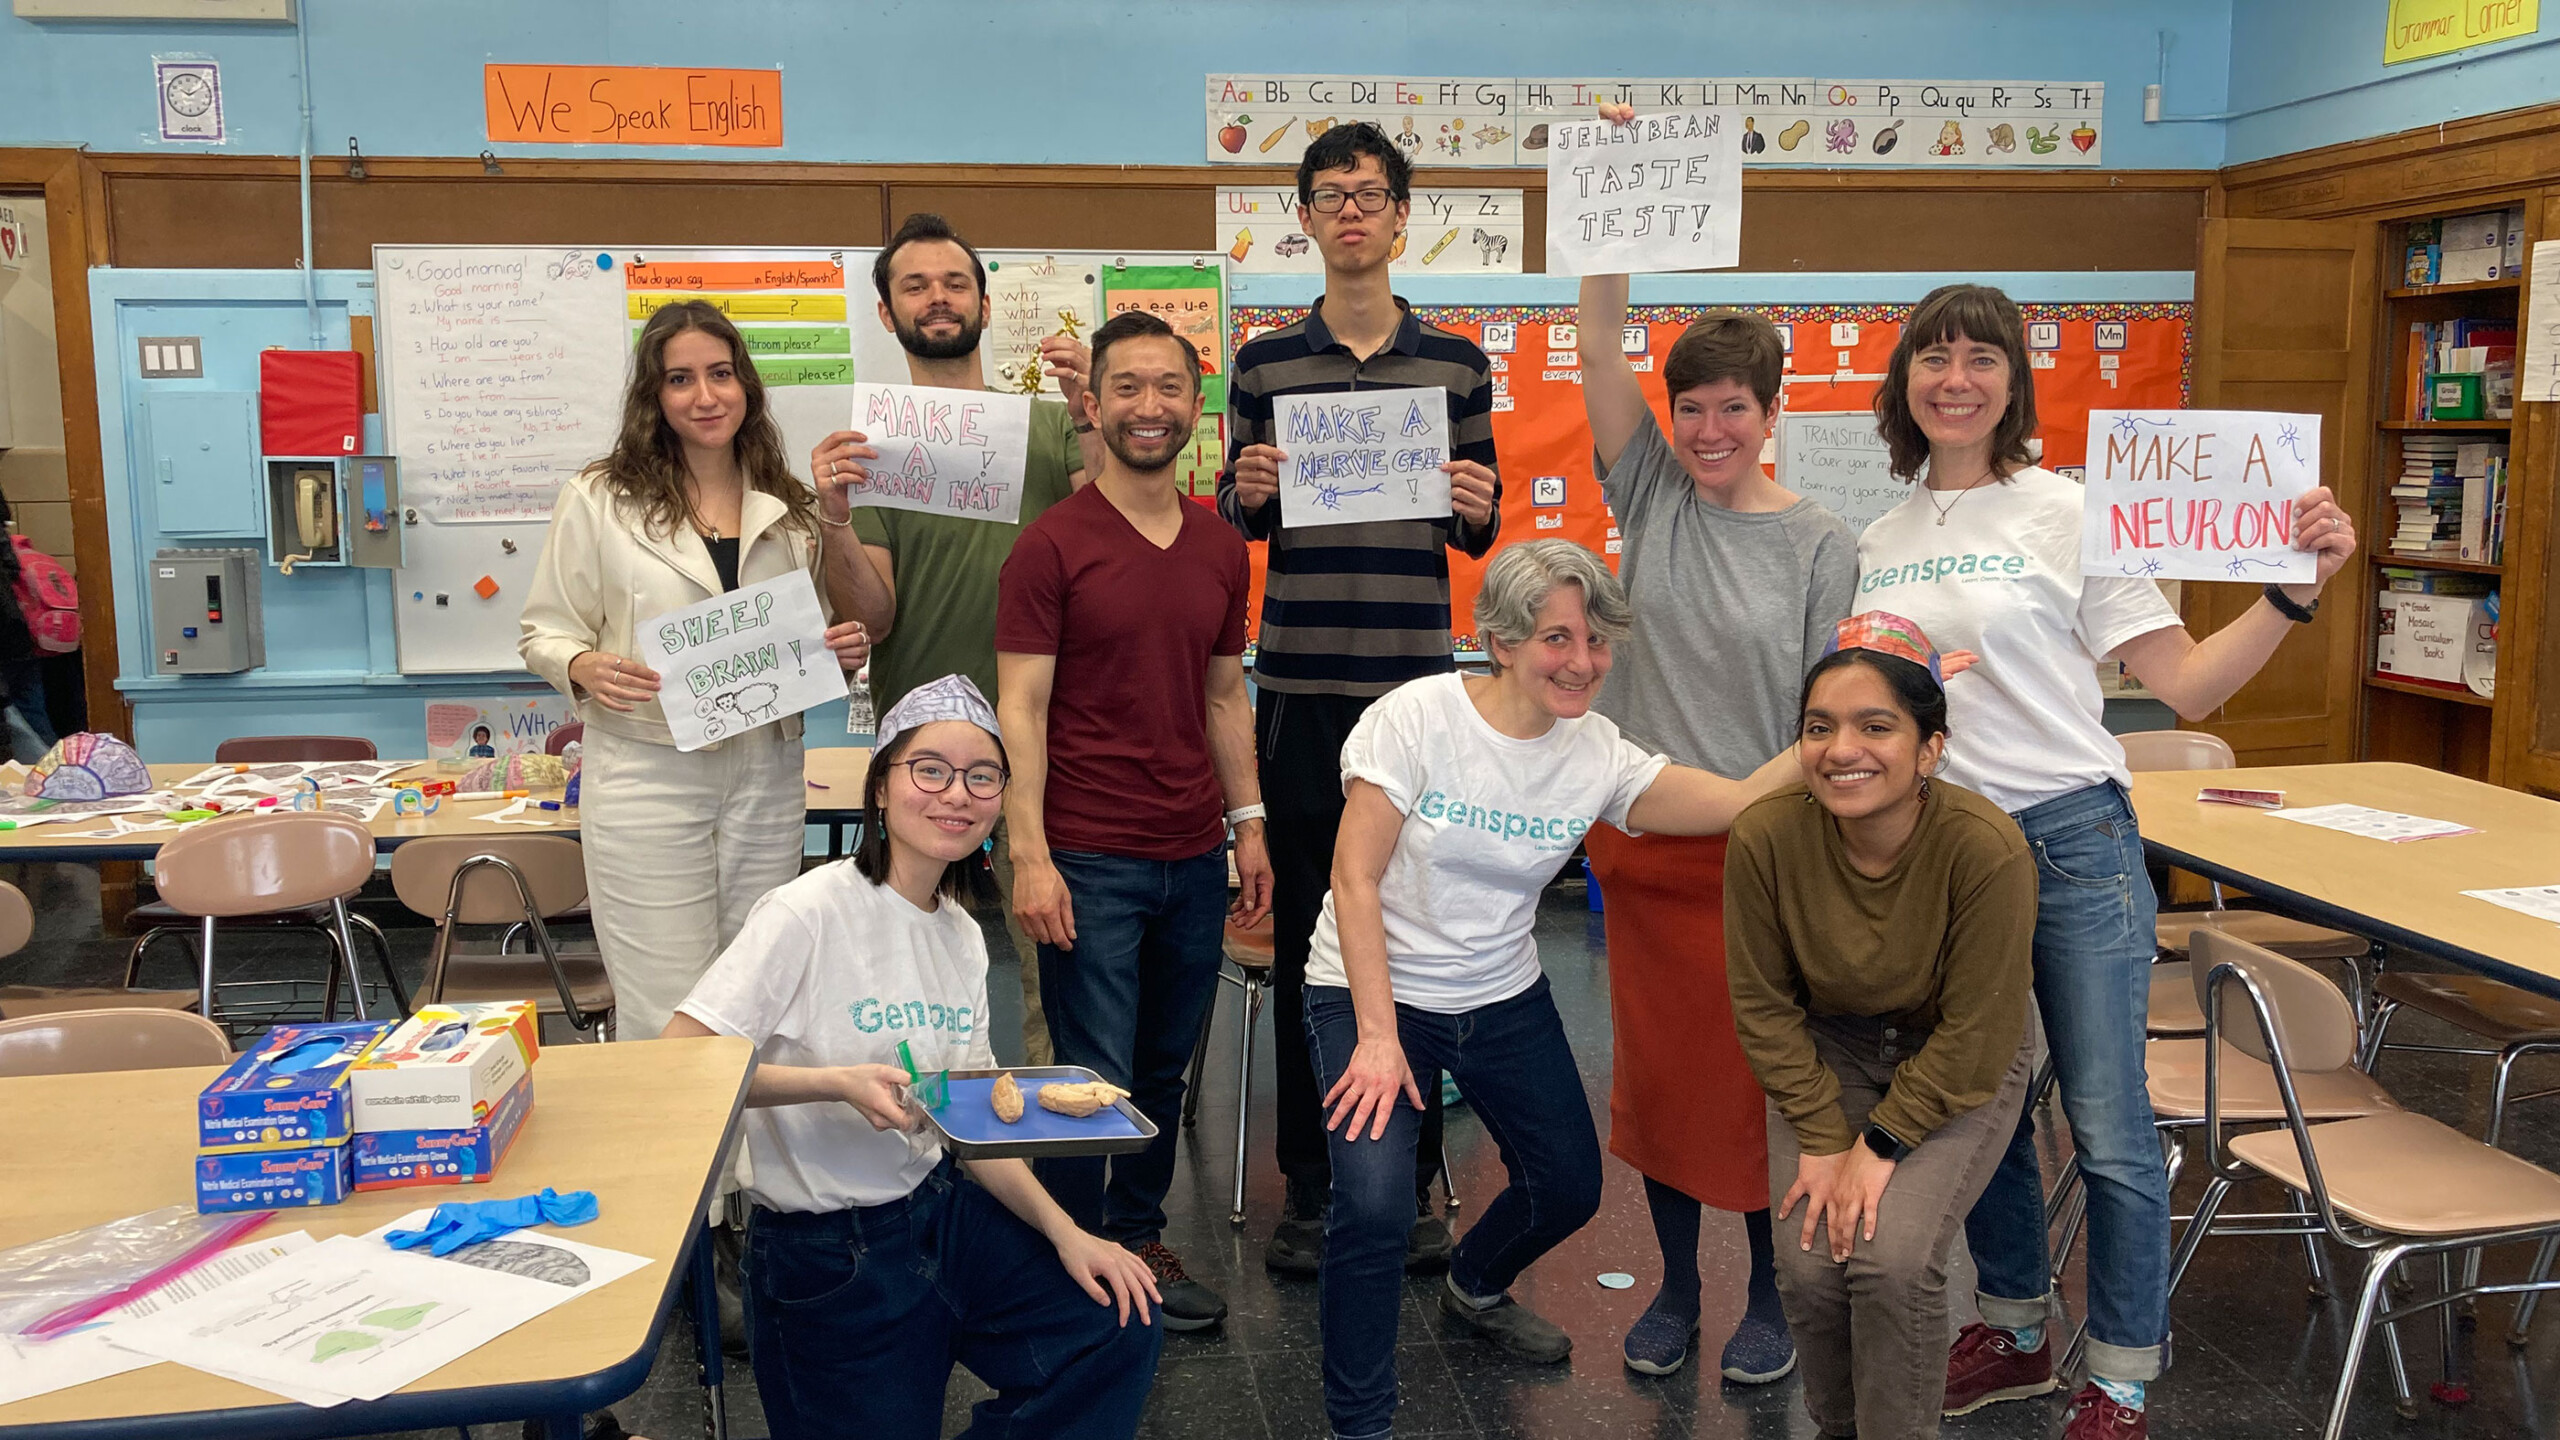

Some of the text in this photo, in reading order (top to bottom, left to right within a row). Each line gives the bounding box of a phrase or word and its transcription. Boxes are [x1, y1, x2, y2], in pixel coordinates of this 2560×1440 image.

[2394, 0, 2455, 49] Grammar
[1222, 81, 1506, 115] Aa Bb Cc Dd Ee Ff Gg
[1527, 85, 1553, 106] Hh
[1571, 85, 1592, 105] Ii
[1661, 85, 1684, 106] Kk
[1702, 85, 1718, 105] Ll
[1736, 85, 1769, 106] Mm
[1781, 86, 1807, 105] Nn
[1828, 85, 1857, 106] Oo
[1879, 86, 1900, 116] Pp
[1992, 86, 2012, 107] Rr
[2034, 86, 2052, 108] Ss
[2070, 88, 2091, 109] Tt
[498, 71, 765, 140] We Speak English
[1558, 115, 1720, 150] JELLYBEAN
[1572, 154, 1709, 198] TASTE
[1229, 193, 1499, 225] Uu Yy Zz
[1578, 204, 1711, 242] TEST!
[627, 267, 838, 289] How do you say in English/Spanish?
[999, 283, 1039, 302] who
[424, 292, 544, 317] What is your name?
[1004, 303, 1042, 320] what
[1150, 302, 1175, 313] e-e
[1184, 300, 1209, 311] u-e
[455, 316, 483, 326] name
[1008, 320, 1045, 338] when
[430, 332, 539, 352] How old are you?
[1489, 327, 1509, 342] Dd
[1554, 327, 1571, 342] Ee
[1841, 325, 1850, 338] Ii
[2100, 328, 2122, 340] Mm
[784, 334, 820, 353] please?
[509, 353, 543, 366] years
[1491, 355, 1507, 371] do
[1548, 352, 1574, 363] each
[2033, 352, 2054, 364] like
[433, 374, 470, 388] Where
[476, 374, 493, 385] are
[499, 374, 515, 388] you
[761, 365, 847, 384] pencil please?
[1544, 370, 1582, 383] every
[438, 403, 569, 422] Do you have any siblings?
[867, 388, 988, 447] MAKE
[1287, 399, 1431, 444] MAKE A
[1199, 426, 1216, 435] ank
[440, 440, 470, 451] Where
[475, 439, 487, 449] do
[490, 441, 505, 453] you
[902, 441, 937, 477] A
[1205, 452, 1218, 461] ive
[1811, 451, 1841, 468] Cover
[1848, 457, 1870, 474] your
[2105, 433, 2273, 488] MAKE A
[443, 464, 550, 482] What is your favorite
[1293, 447, 1446, 488] NERVE CELL
[855, 469, 1009, 512] BRAIN HAT
[1196, 477, 1214, 486] onk
[1540, 483, 1557, 496] Rr
[1800, 476, 1878, 511] Covering your
[2110, 497, 2293, 556] NEURON
[1861, 553, 2026, 594] Genspace
[2412, 602, 2431, 612] Grade
[659, 592, 774, 655] SHEEP
[2408, 616, 2436, 629] Mosaic
[2424, 647, 2445, 659] Books
[1419, 790, 1588, 842] Genspace
[264, 1096, 327, 1113] SunnyCare
[416, 1133, 477, 1149] SunnyCare
[261, 1159, 324, 1174] SunnyCare
[419, 1165, 428, 1175] S
